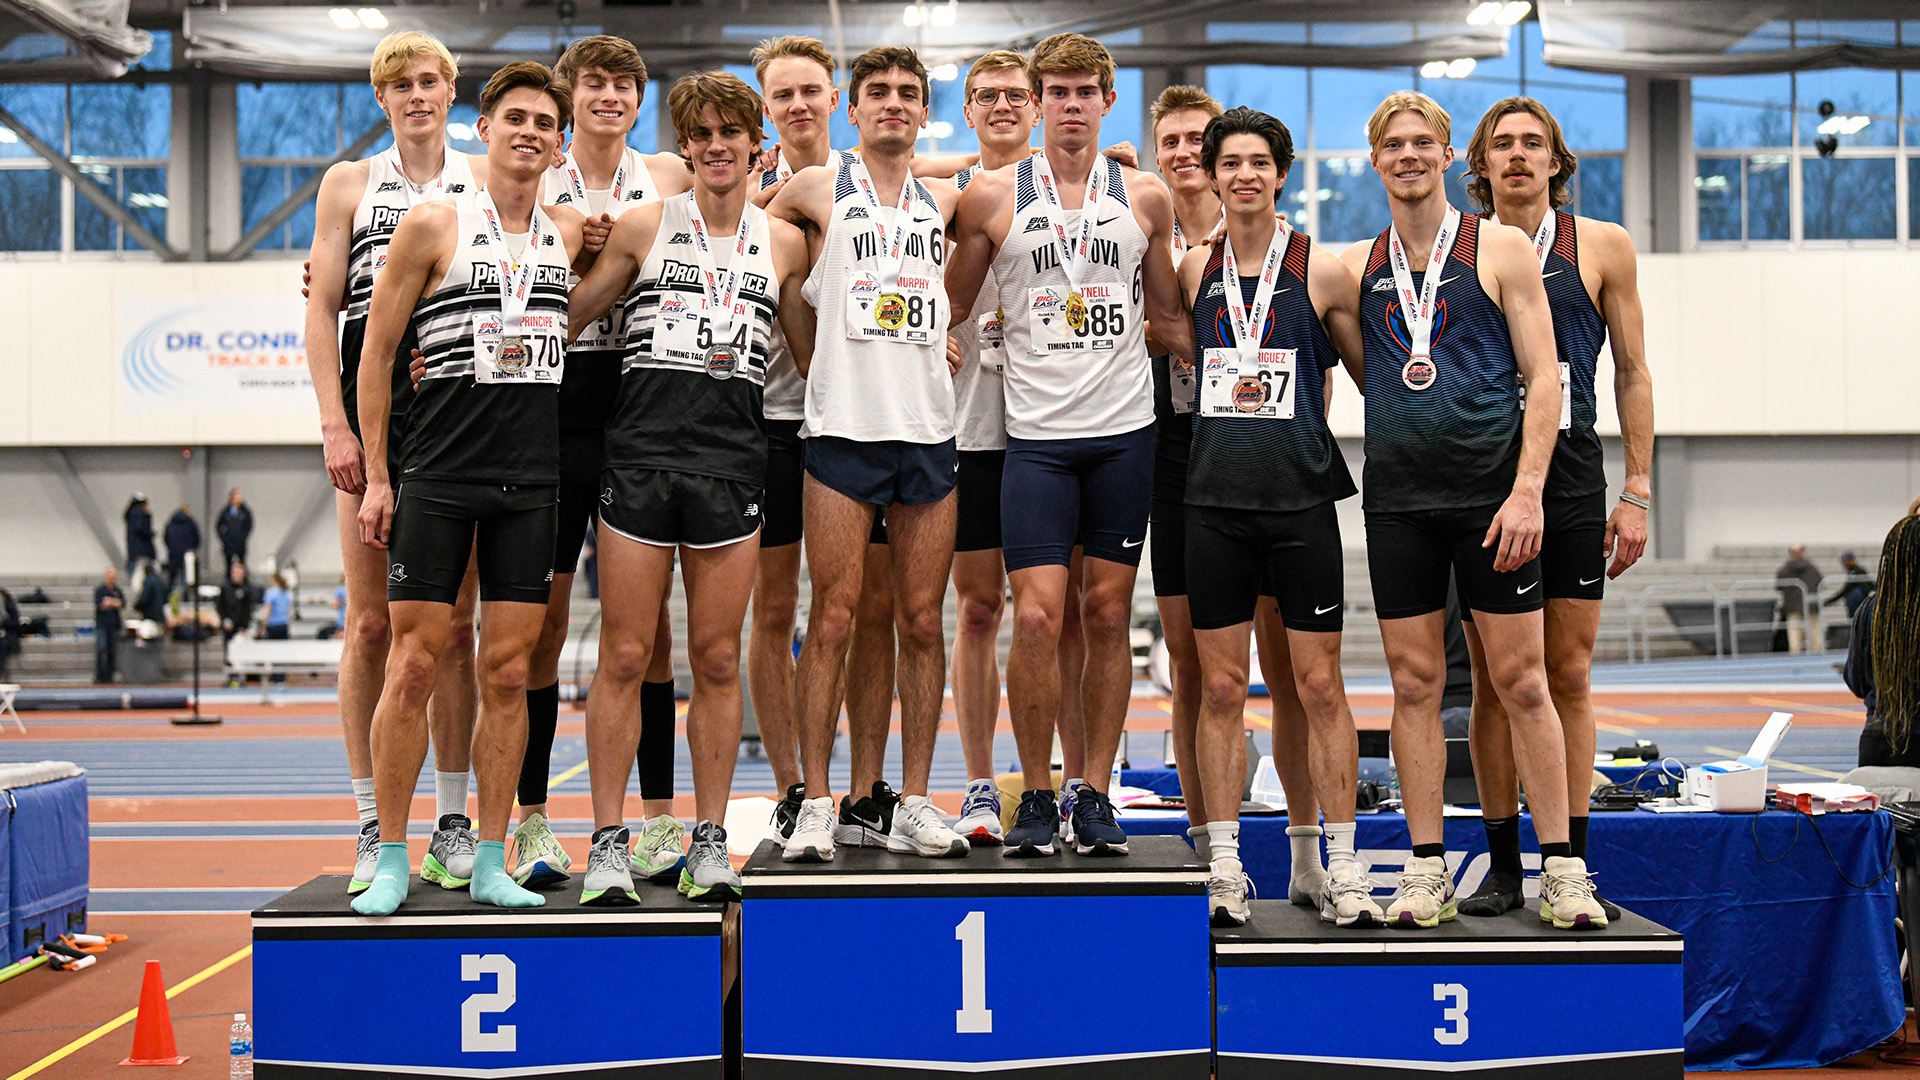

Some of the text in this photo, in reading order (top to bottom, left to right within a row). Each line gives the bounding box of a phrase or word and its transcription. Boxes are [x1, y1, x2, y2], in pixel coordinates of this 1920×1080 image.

[862, 179, 877, 207] BIG EAST
[1047, 186, 1057, 205] EAST
[487, 209, 501, 242] BIG EAST
[695, 219, 708, 252] BIG EAST
[894, 226, 902, 245] EAST
[1026, 222, 1050, 230] EAS
[1081, 219, 1090, 241] EAST
[1058, 225, 1072, 261] BIG EAST
[1438, 228, 1448, 250] EAST
[1268, 249, 1277, 270] EAST
[1397, 252, 1405, 271] EAST
[516, 263, 530, 299] BIG EAST
[726, 271, 735, 292] EAST
[897, 277, 929, 289] MURPHY
[1406, 289, 1414, 303] BIG
[519, 316, 553, 327] PRINCIPE
[1253, 302, 1262, 323] EAST
[166, 331, 306, 351] DR. CONR
[696, 317, 748, 355] 54
[863, 328, 886, 336] TIMING
[886, 329, 899, 338] TAG
[666, 349, 703, 361] TIMING TAG
[1047, 342, 1070, 350] TIMING
[1071, 341, 1084, 349] TAG
[208, 353, 269, 367] TRACK
[277, 354, 288, 367] &
[955, 911, 993, 1033] 1
[461, 953, 517, 1052] 2
[1433, 983, 1469, 1045] 3
